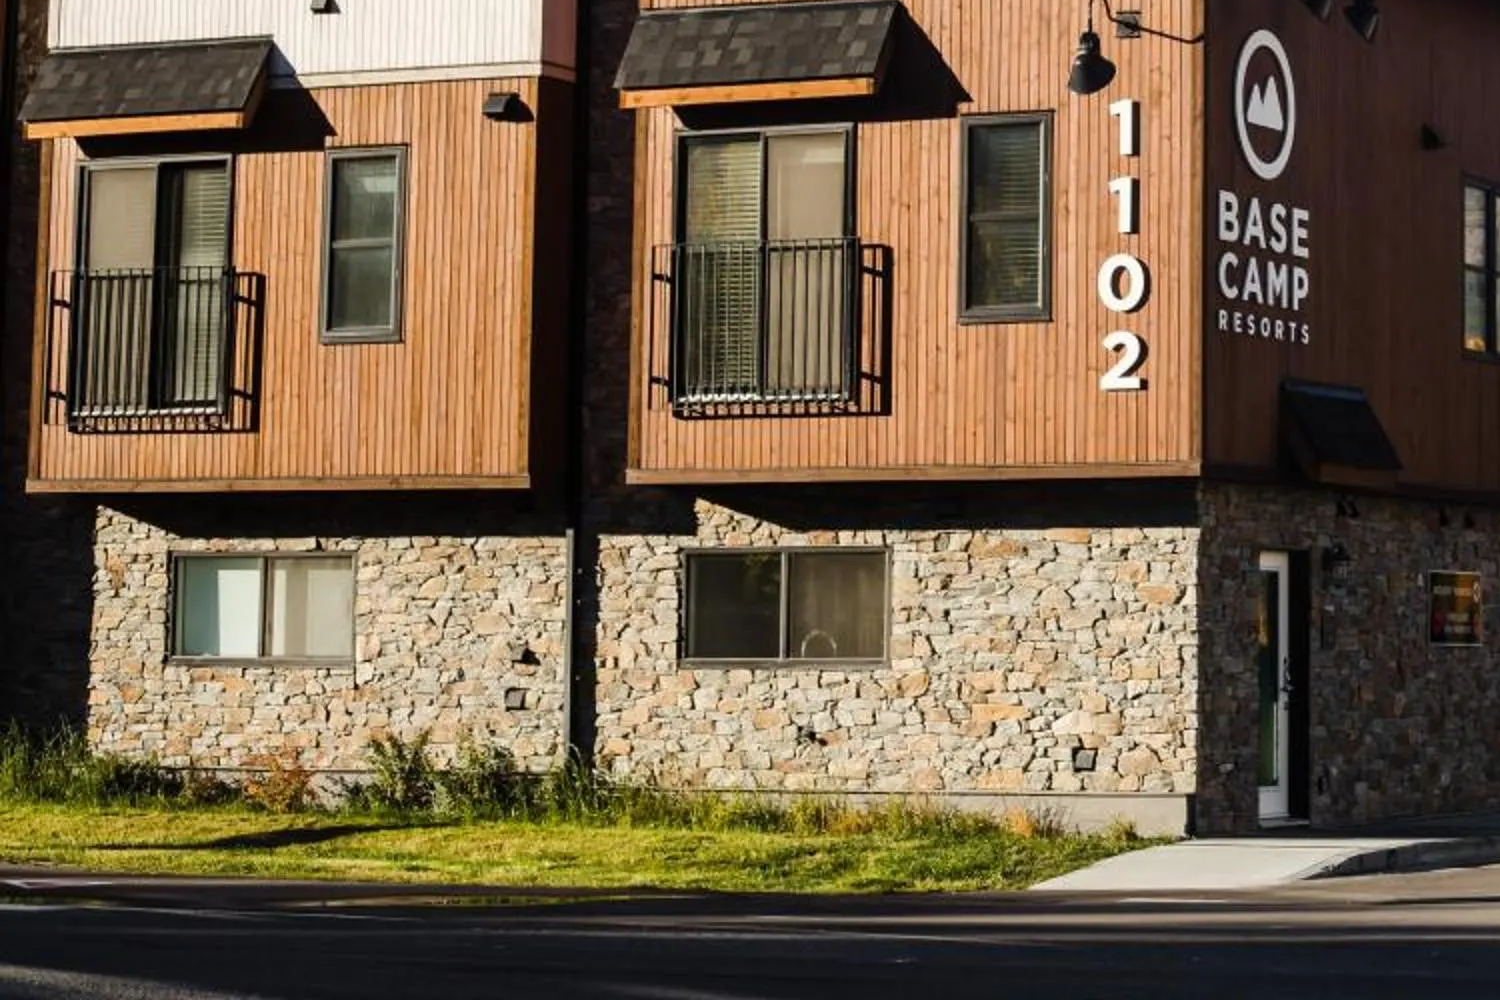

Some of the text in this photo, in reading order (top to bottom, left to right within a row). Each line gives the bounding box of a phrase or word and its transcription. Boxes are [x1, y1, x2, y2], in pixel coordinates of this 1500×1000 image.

[1098, 98, 1148, 391] 1102
[1218, 190, 1310, 258] BASE
[1218, 253, 1309, 311] CAMP
[1219, 310, 1309, 344] RESORTS
